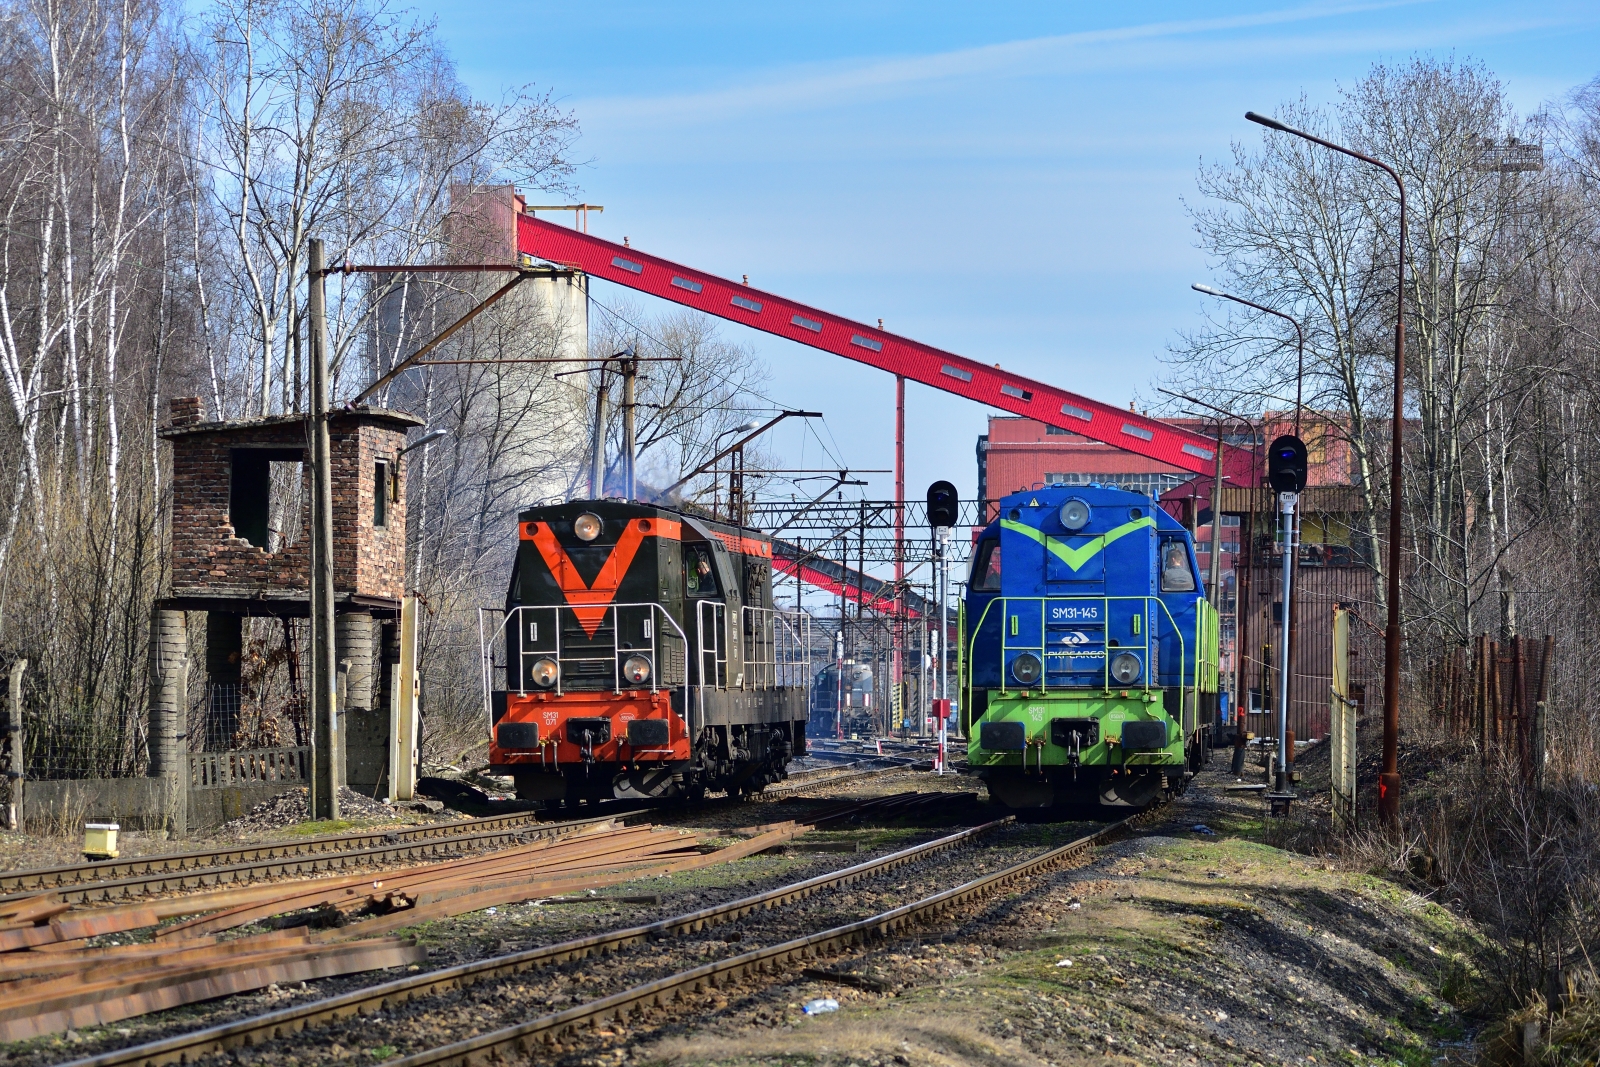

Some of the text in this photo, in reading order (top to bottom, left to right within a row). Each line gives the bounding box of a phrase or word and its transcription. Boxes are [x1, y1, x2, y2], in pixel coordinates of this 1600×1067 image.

[1052, 607, 1098, 619] SM31-145
[1028, 706, 1045, 714] SM31
[542, 711, 559, 719] SM31
